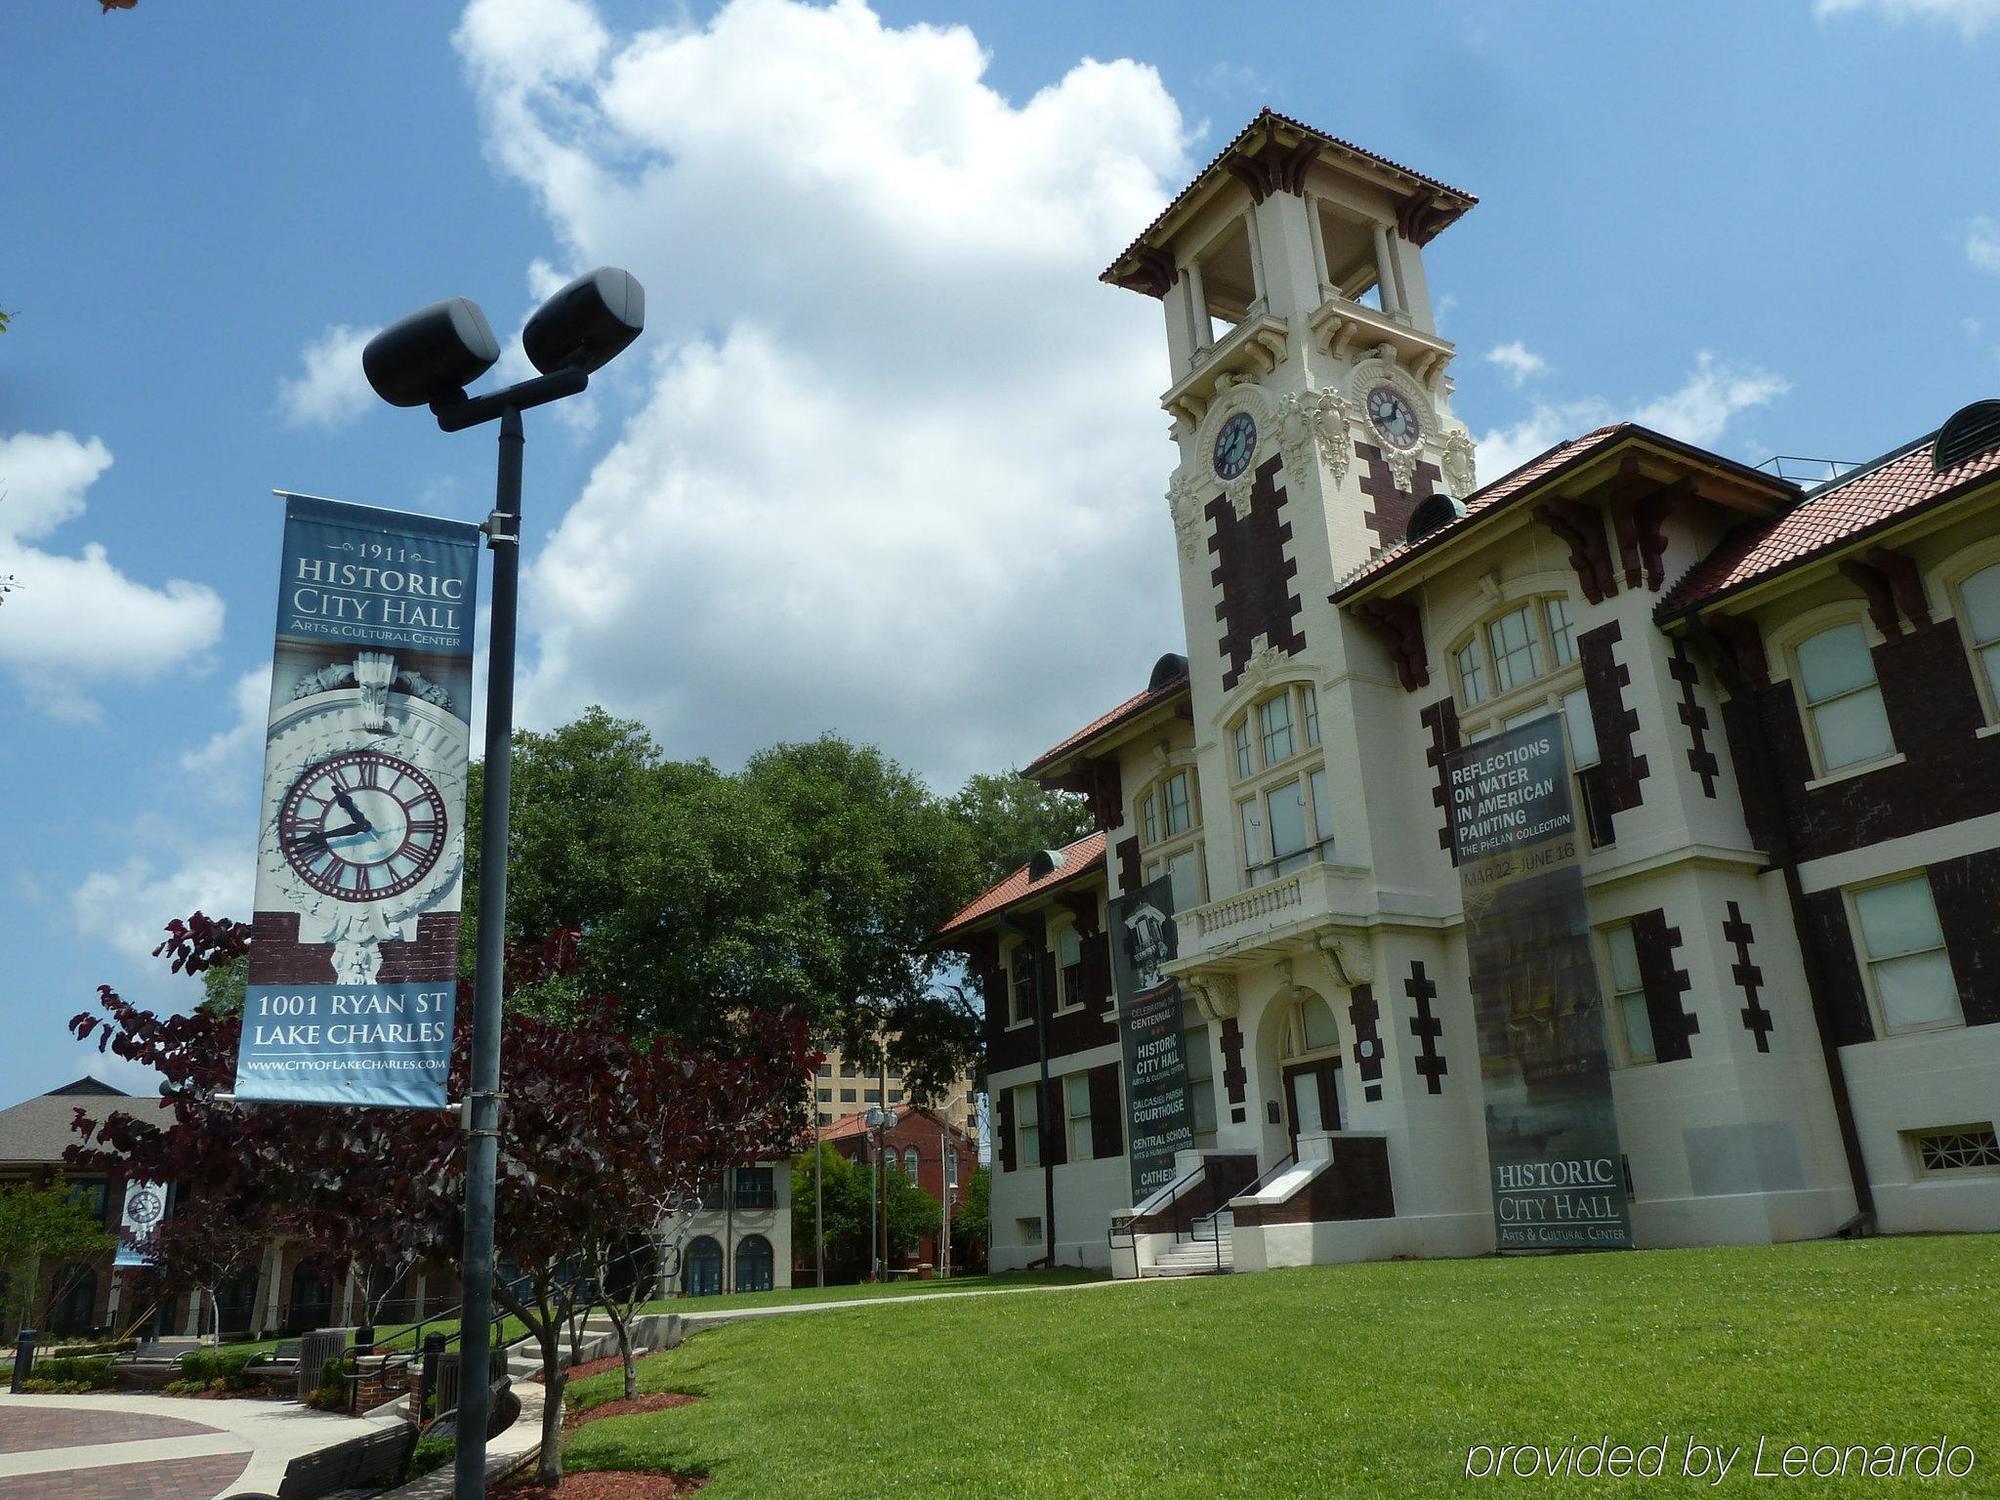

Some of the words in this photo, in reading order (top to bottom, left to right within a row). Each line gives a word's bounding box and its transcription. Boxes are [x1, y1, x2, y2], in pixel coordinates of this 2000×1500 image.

[359, 543, 406, 563] 1911
[298, 557, 464, 599] HISTORIC
[294, 588, 371, 620] CITY
[382, 599, 460, 630] HALL
[290, 620, 328, 634] ARTS
[330, 626, 339, 635] &
[342, 626, 411, 643] CULTURAL
[412, 633, 460, 647] CENTER
[1451, 738, 1550, 785] REFLECTIONS
[1455, 785, 1475, 804] ON
[1478, 767, 1529, 796] WATER
[1457, 804, 1472, 823] IN
[1477, 778, 1553, 817] AMERICAN
[1459, 809, 1527, 842] PAINTING
[1460, 843, 1478, 857] THE
[1481, 833, 1513, 853] PHELAN
[1516, 814, 1571, 840] COLLECTION
[1464, 867, 1493, 889] MAR
[1521, 851, 1553, 874] JUNE
[1556, 842, 1575, 862] 16
[259, 995, 318, 1016] 1001
[331, 994, 405, 1015] RYAN
[416, 992, 447, 1013] ST
[255, 1024, 320, 1045] LAKE
[327, 1021, 445, 1045] CHARLES
[1137, 1033, 1177, 1059] HISTORIC
[1136, 1058, 1159, 1075] CITY
[1161, 1050, 1180, 1069] HALL
[1134, 1099, 1185, 1123] COURTHOUSE
[1133, 1134, 1166, 1150] CENTRAL
[1166, 1126, 1192, 1142] SCHOOL
[1497, 1158, 1614, 1188] HISTORIC
[1499, 1196, 1547, 1221] CITY
[1552, 1194, 1619, 1220] HALL
[1502, 1228, 1524, 1241] ARTS
[1527, 1228, 1537, 1241] &
[1539, 1227, 1584, 1241] CULTURAL
[1588, 1226, 1625, 1240] CENTER
